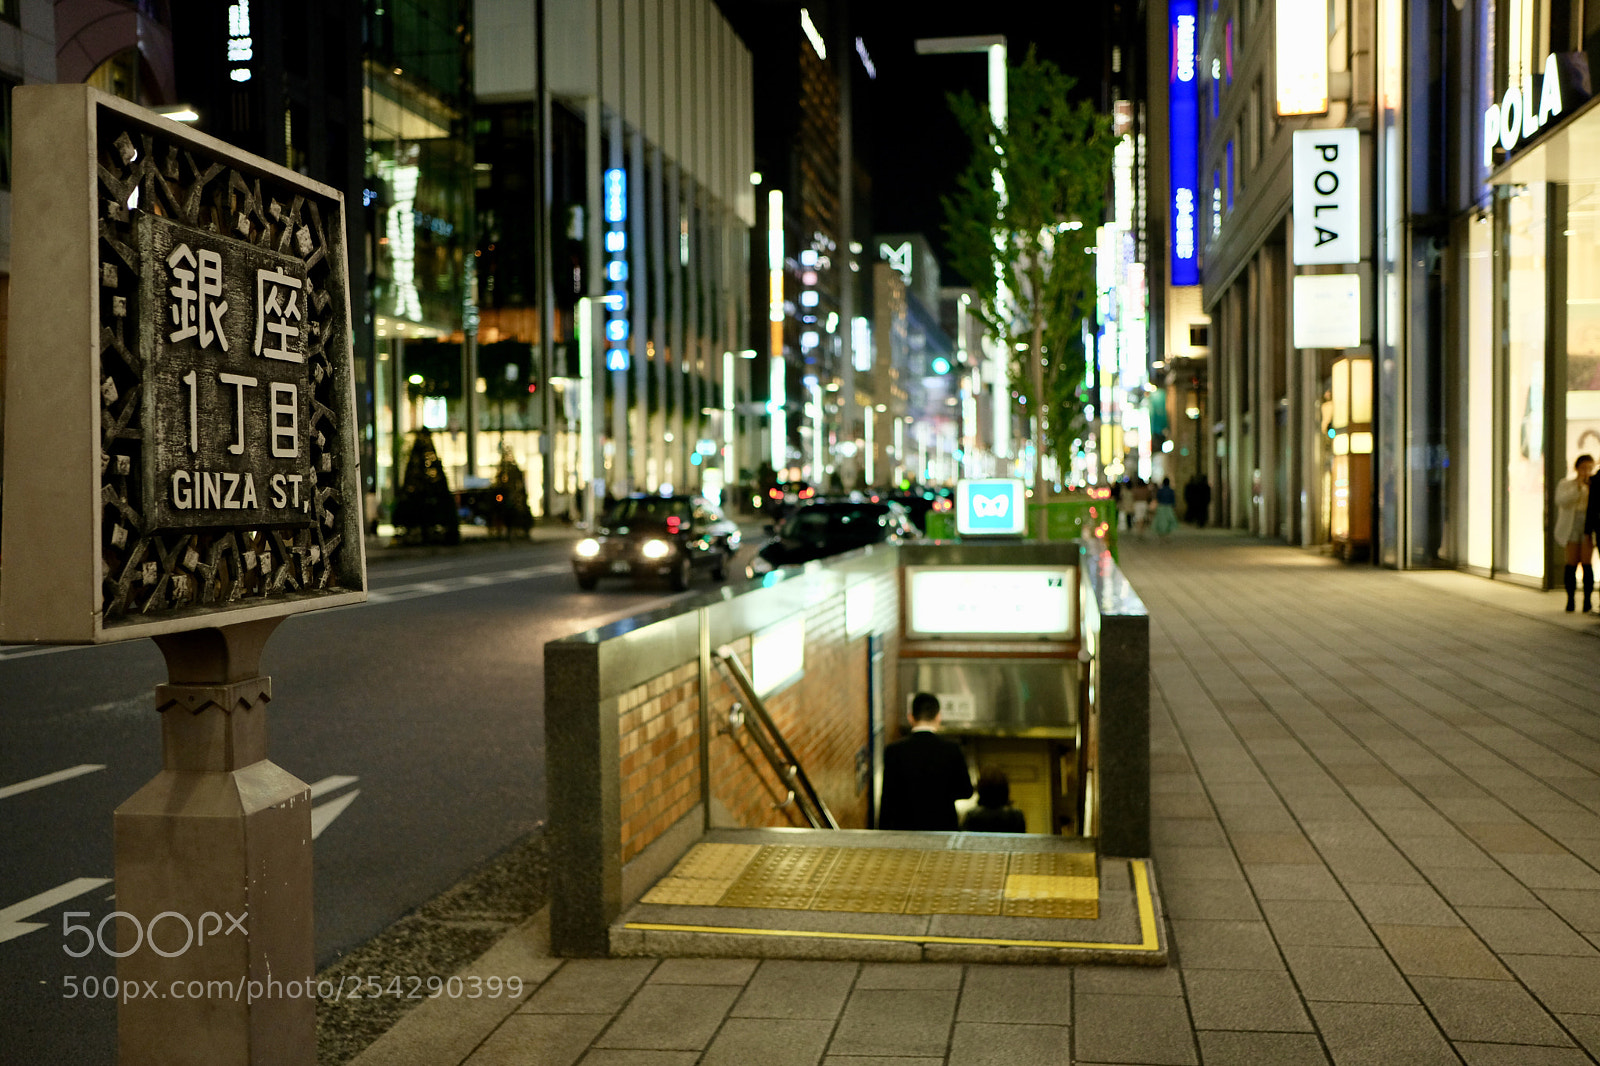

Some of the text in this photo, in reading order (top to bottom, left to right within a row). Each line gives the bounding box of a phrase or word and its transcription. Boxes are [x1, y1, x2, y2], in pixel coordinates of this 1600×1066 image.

[1484, 52, 1563, 167] POLA
[1314, 144, 1339, 248] POLA
[166, 243, 303, 363] 銀座
[182, 369, 299, 459] 1丁目
[172, 469, 258, 511] GINZA
